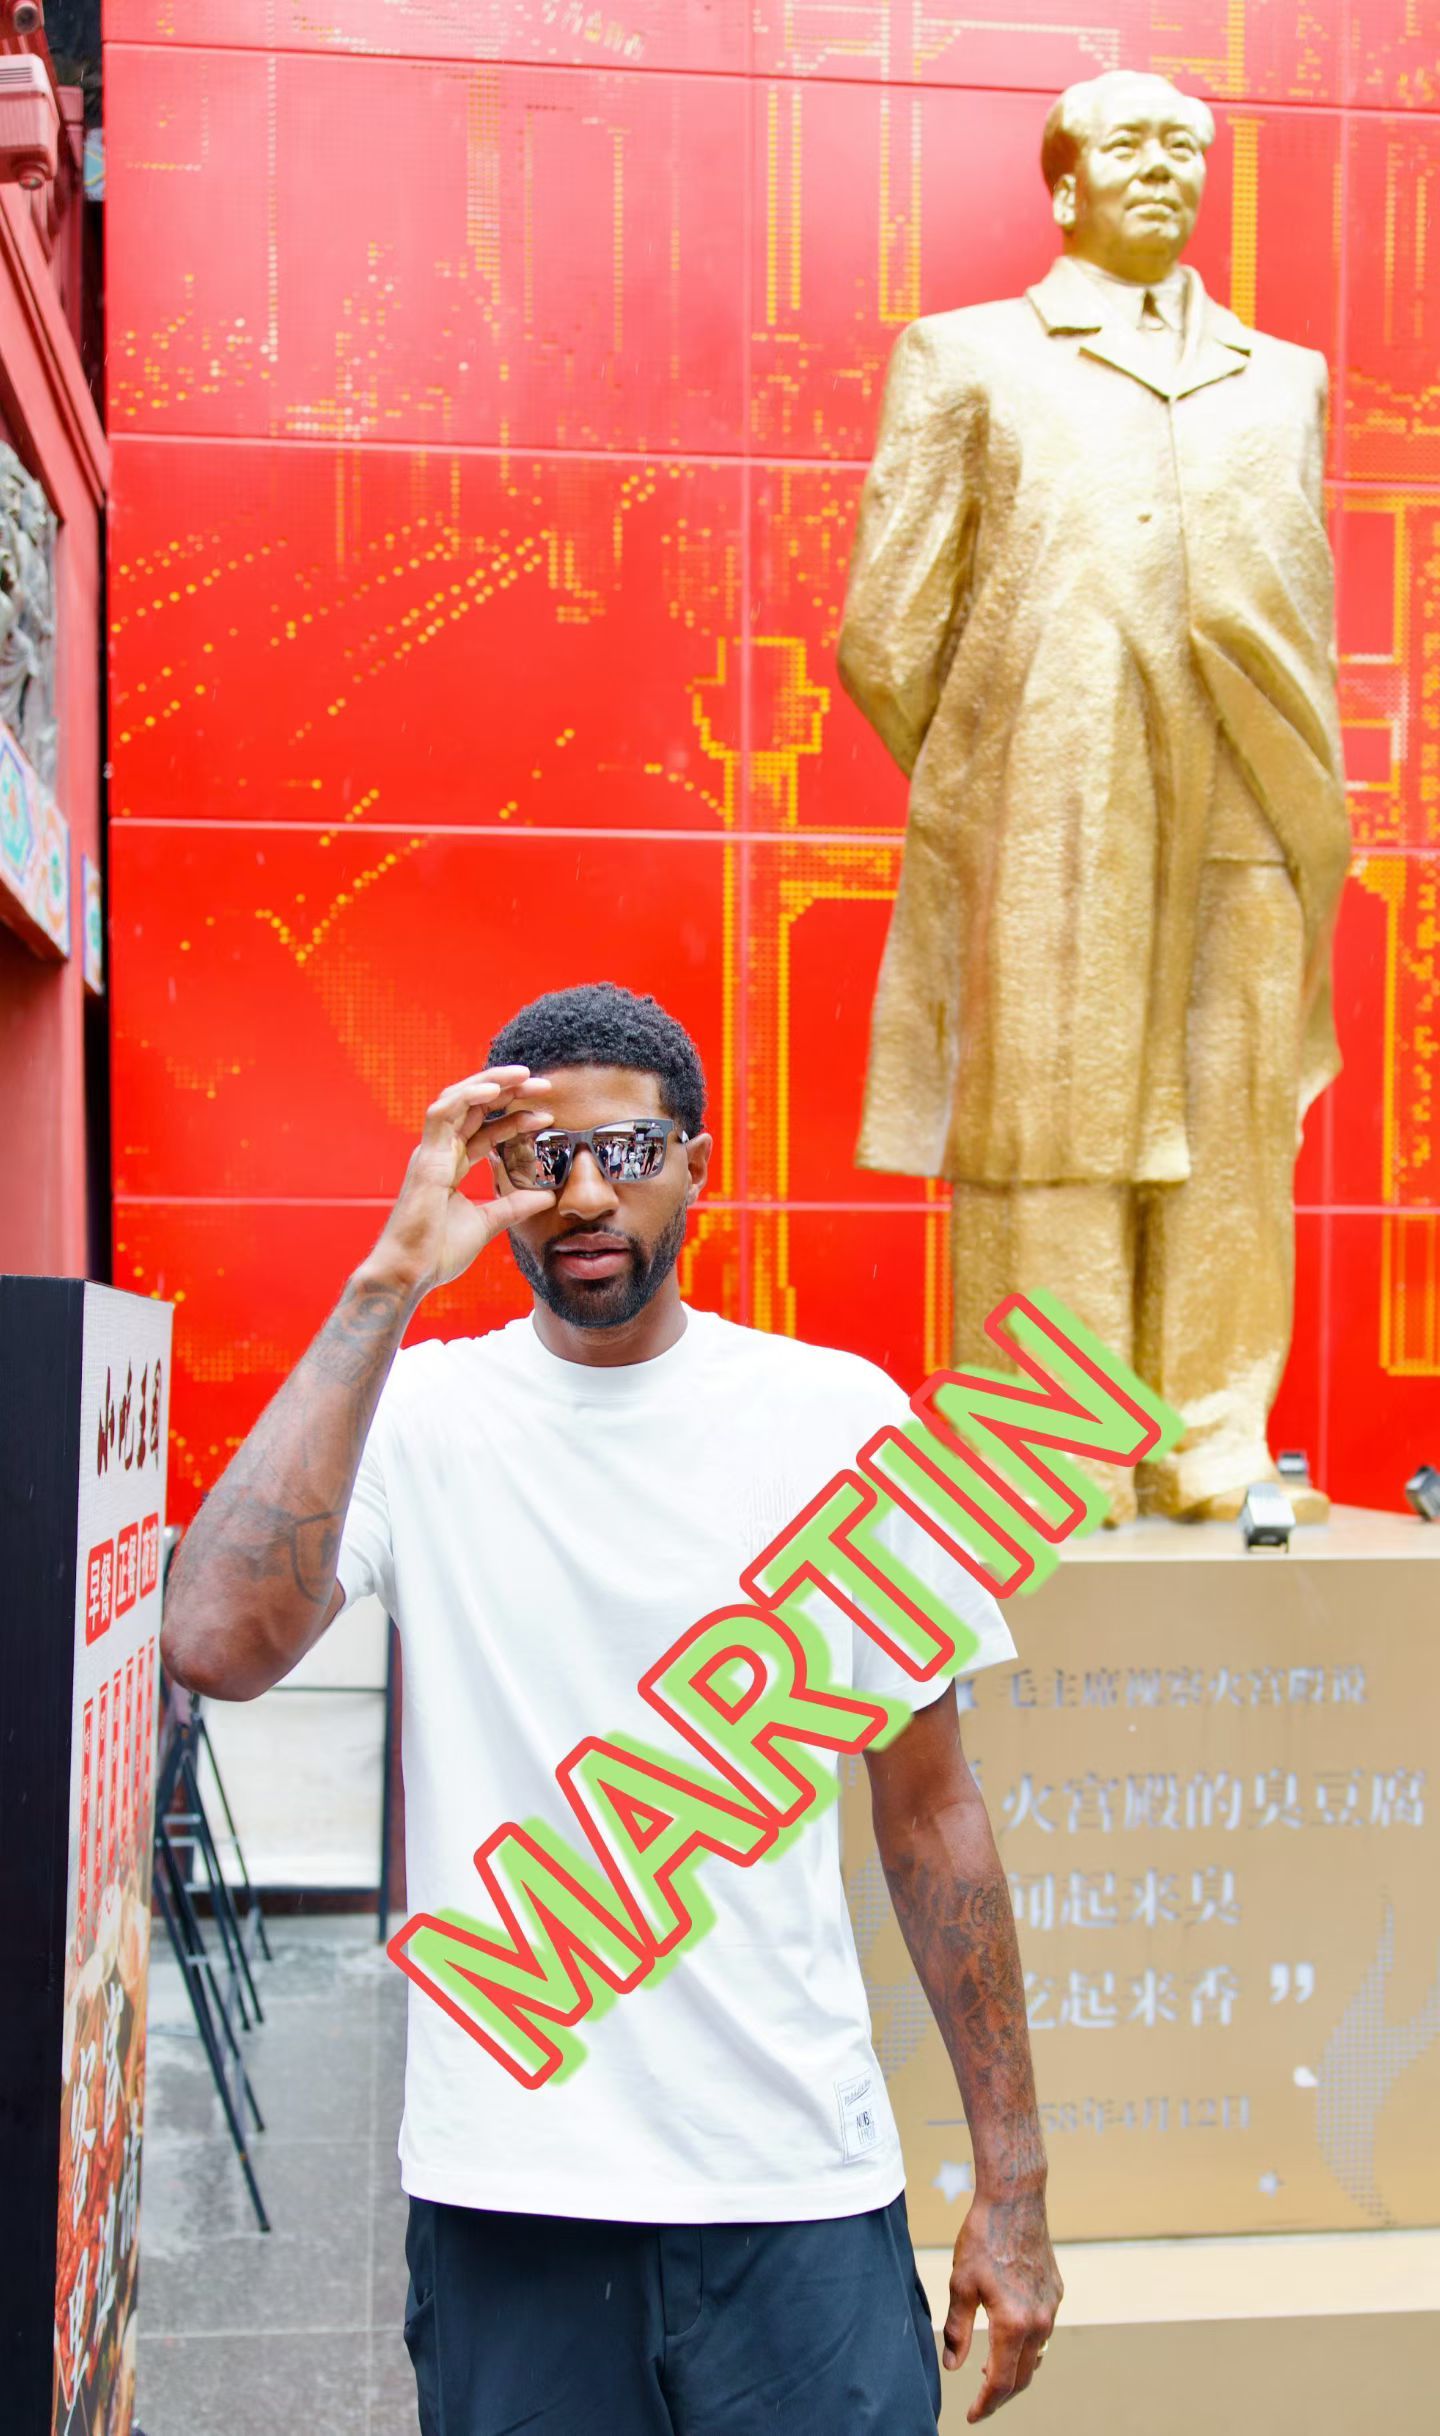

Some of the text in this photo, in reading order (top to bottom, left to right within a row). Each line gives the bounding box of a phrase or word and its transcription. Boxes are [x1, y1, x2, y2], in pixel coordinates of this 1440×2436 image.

[88, 1552, 112, 1632] 早餐
[116, 1533, 137, 1605] 正餐
[1001, 1767, 1427, 1833] 火宫殿的臭豆腐
